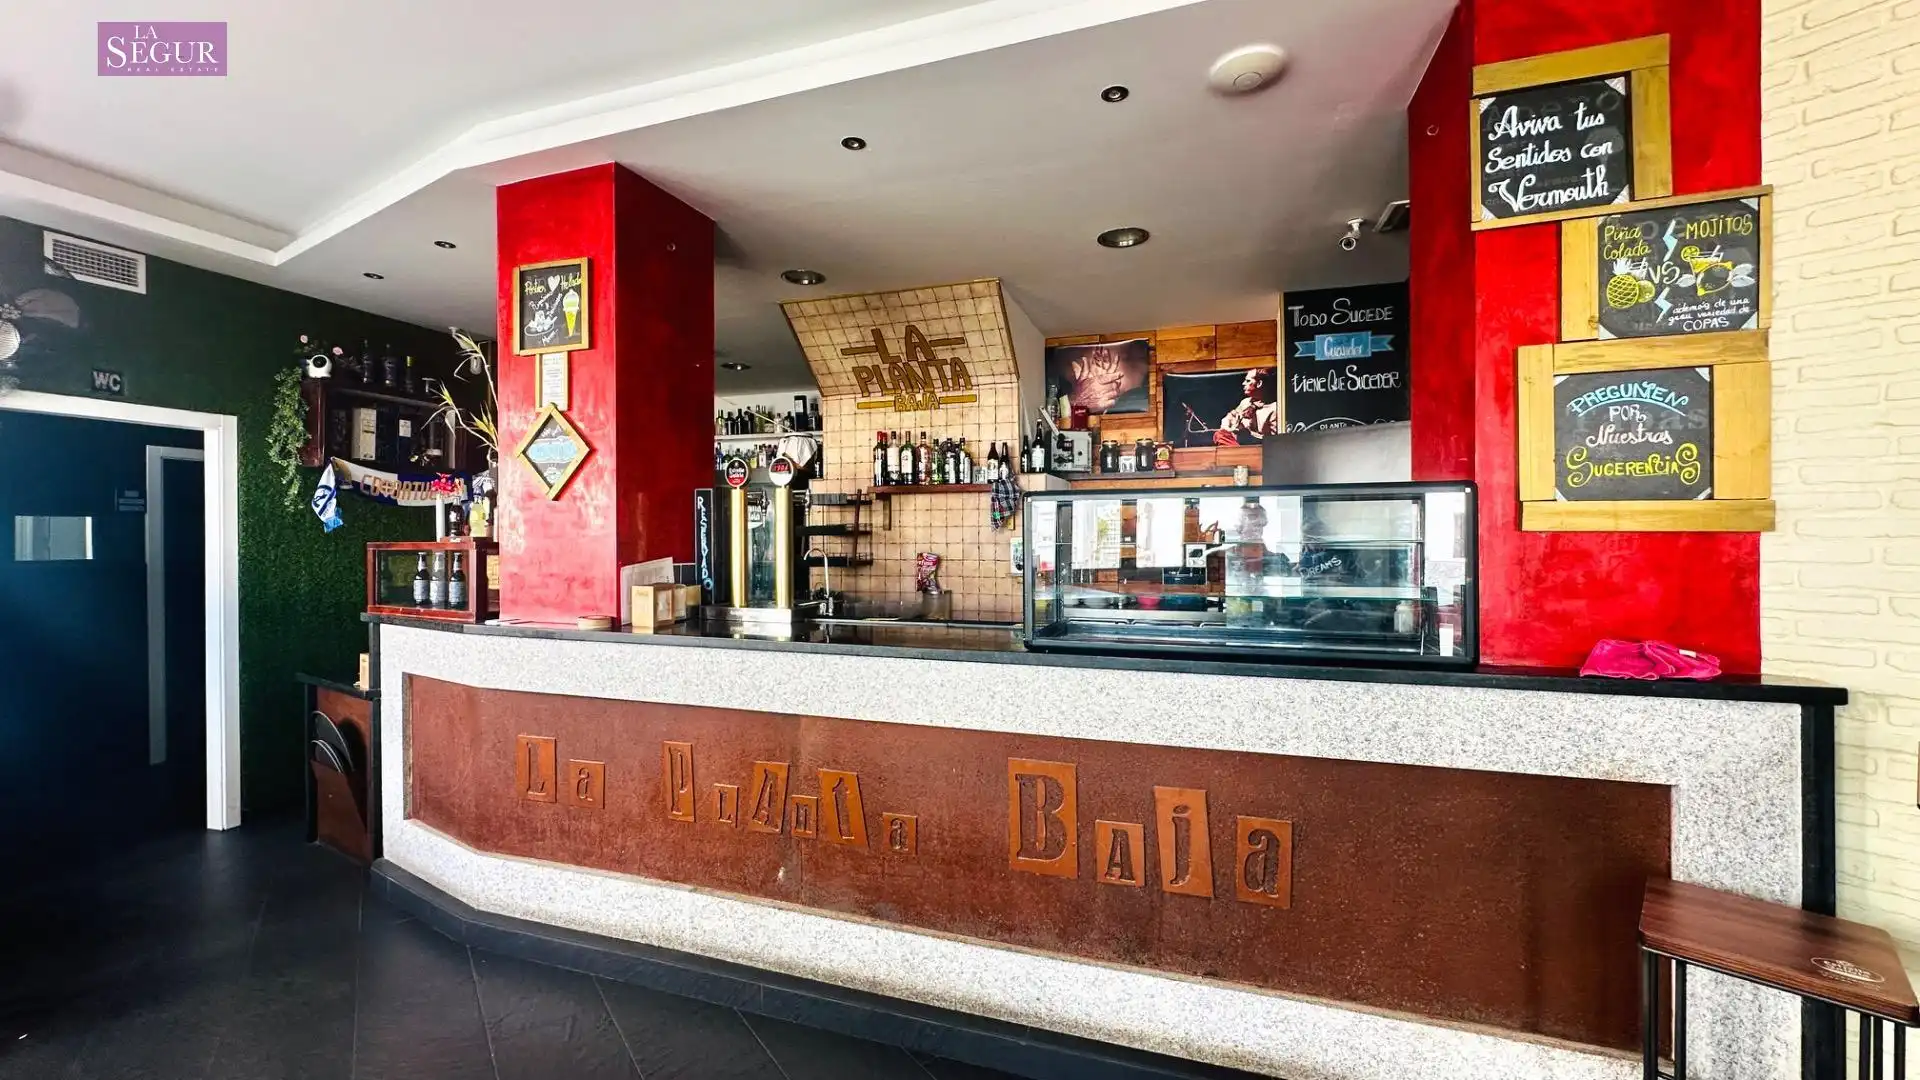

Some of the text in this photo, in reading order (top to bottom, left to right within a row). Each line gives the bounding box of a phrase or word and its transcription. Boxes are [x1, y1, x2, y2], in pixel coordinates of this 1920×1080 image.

[1488, 102, 1605, 141] Aviva tus
[1485, 140, 1613, 173] Sentidos con
[1488, 164, 1610, 213] Vermouth
[1604, 225, 1641, 243] Piña
[1603, 240, 1651, 261] Colada
[1714, 298, 1726, 308] de
[1729, 297, 1750, 306] una
[1738, 304, 1750, 314] de
[1682, 316, 1730, 332] COPAS
[871, 324, 936, 364] LA
[92, 371, 122, 392] WC
[852, 357, 973, 397] PLANTA
[894, 392, 941, 412] BAJA
[1566, 380, 1689, 414] PREGUNTEN
[1608, 403, 1647, 422] POR
[1585, 422, 1674, 448] Nuestras
[697, 496, 714, 591] RESERVADO
[523, 739, 598, 804] La
